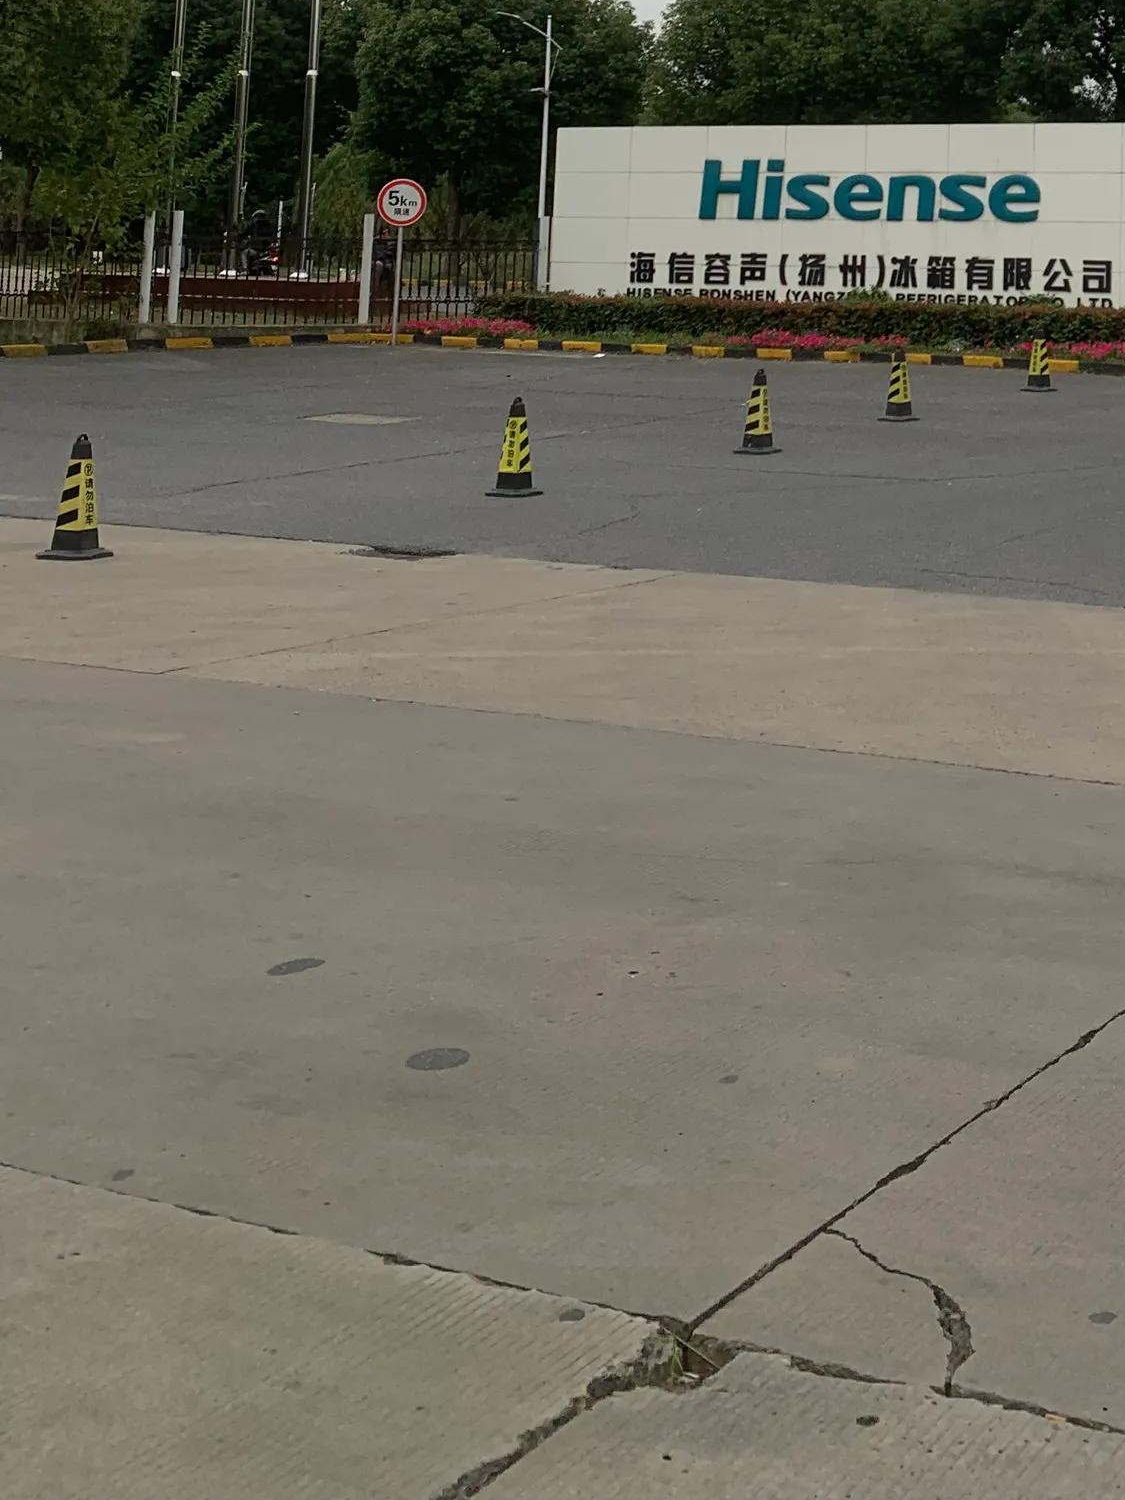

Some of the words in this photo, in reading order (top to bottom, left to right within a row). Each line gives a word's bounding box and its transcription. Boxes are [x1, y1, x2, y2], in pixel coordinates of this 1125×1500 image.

[388, 190, 418, 207] 5km
[698, 159, 1041, 222] Hisense
[84, 478, 95, 526] 请勿泊车
